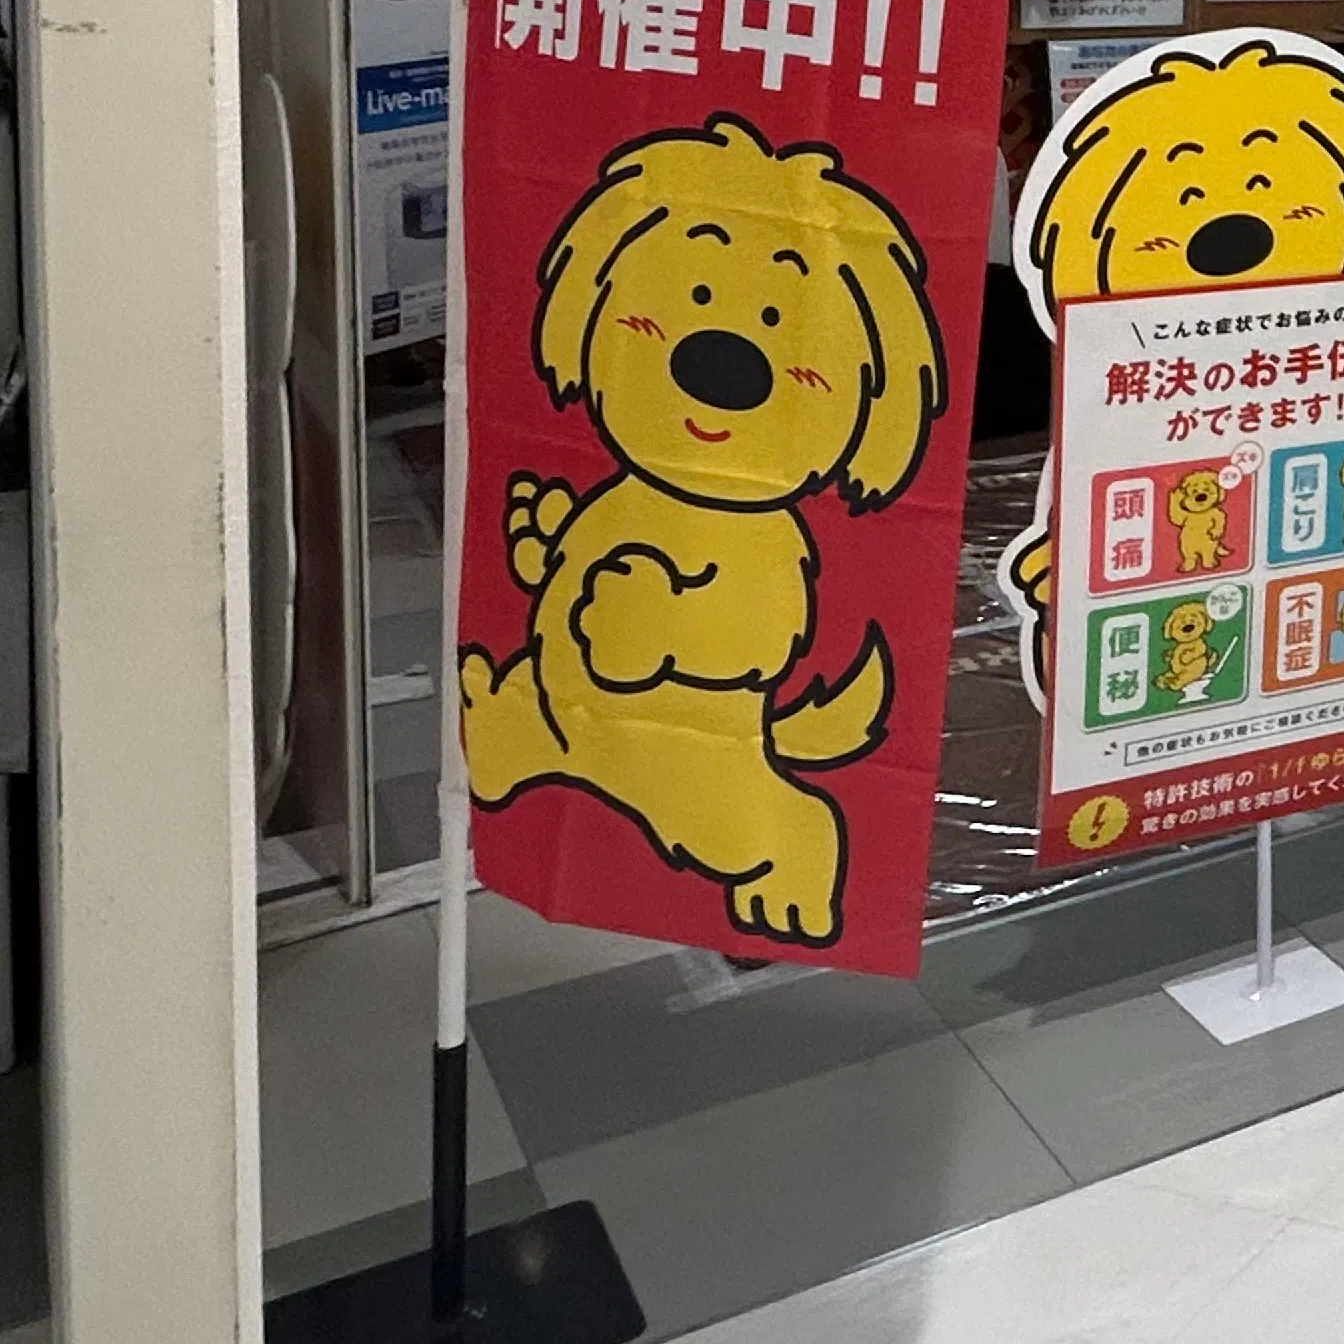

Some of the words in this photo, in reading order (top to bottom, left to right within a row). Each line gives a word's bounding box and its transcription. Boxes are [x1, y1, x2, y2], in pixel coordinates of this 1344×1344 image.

[1111, 488, 1146, 571] 頭痛
[1291, 463, 1320, 543] 肩こり
[1106, 624, 1142, 704] 便秘
[1283, 591, 1316, 672] 不眠症
